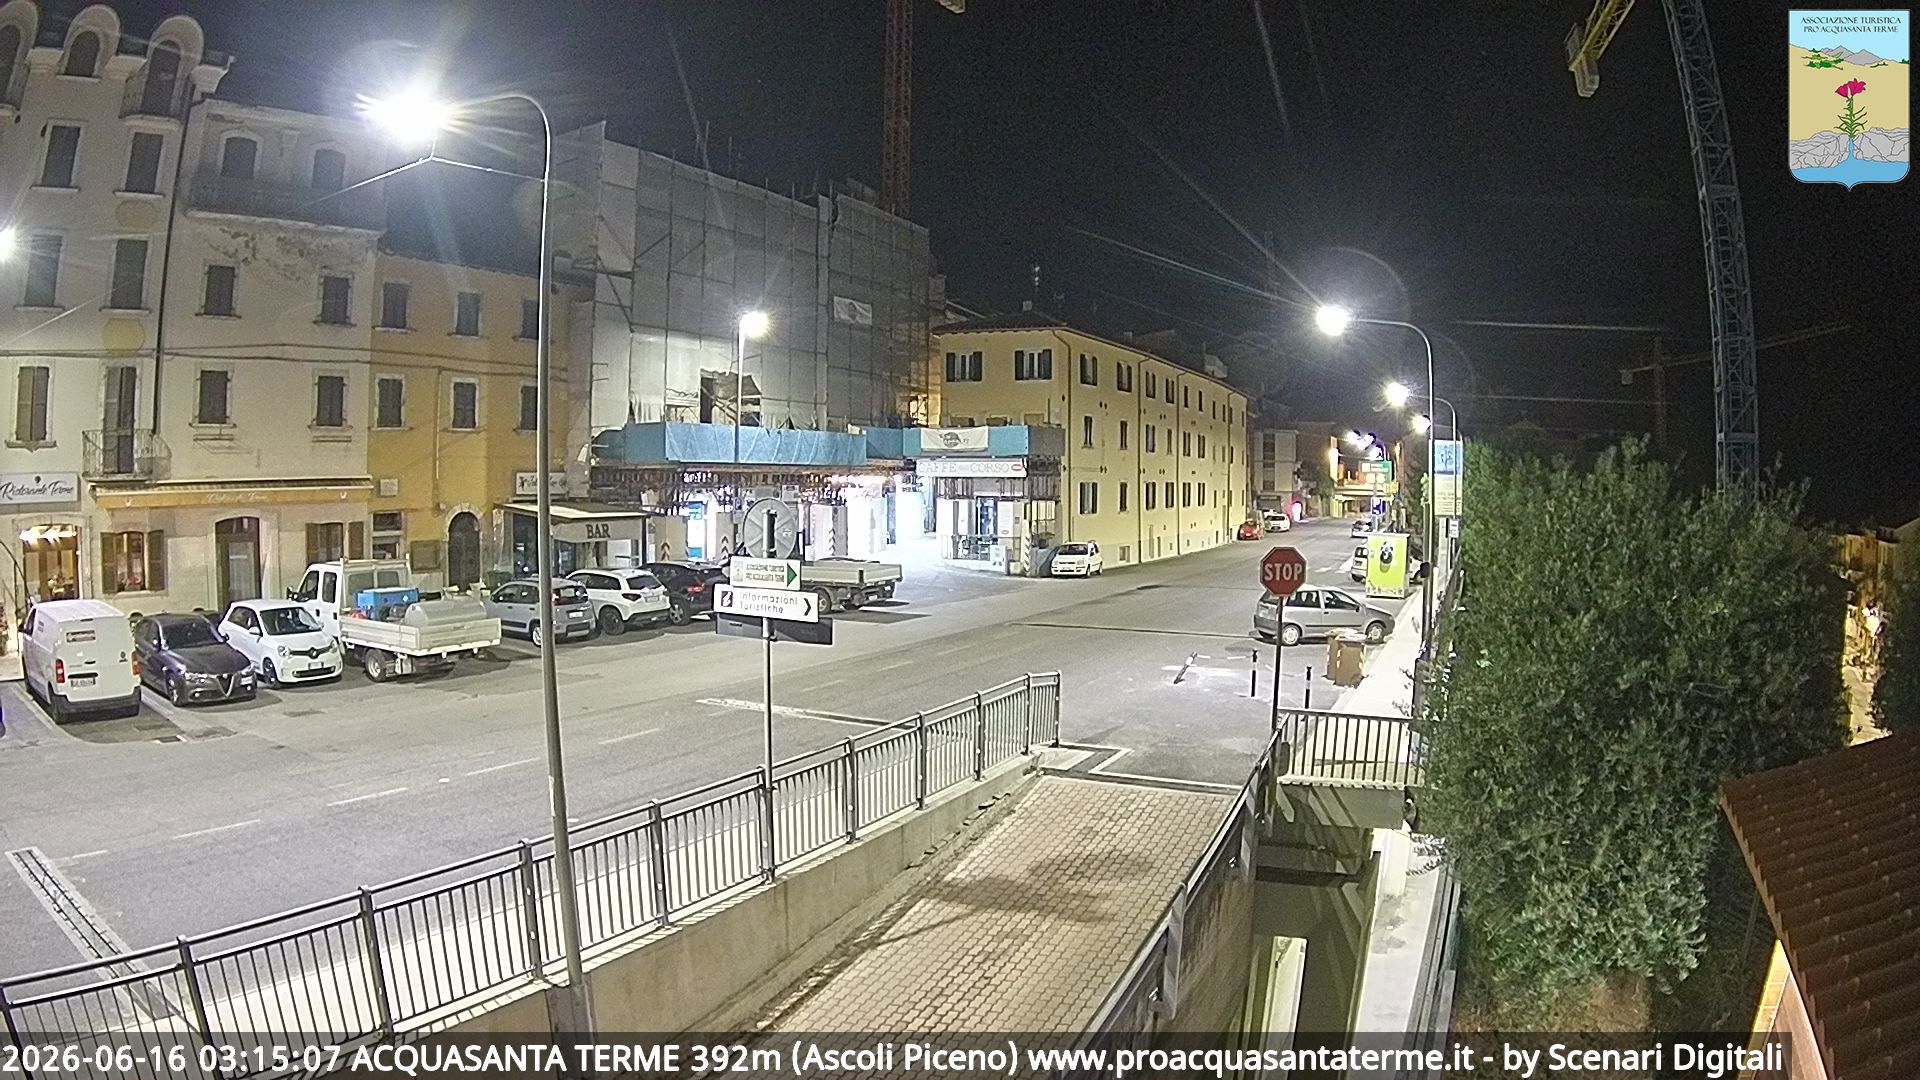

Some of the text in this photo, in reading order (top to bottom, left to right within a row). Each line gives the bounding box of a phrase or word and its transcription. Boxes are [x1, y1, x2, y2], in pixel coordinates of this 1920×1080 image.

[970, 462, 1009, 474] CORSO
[585, 523, 611, 539] BAR
[1264, 562, 1303, 582] STOP
[740, 591, 798, 605] Informazioni
[740, 600, 784, 614] Turistiche
